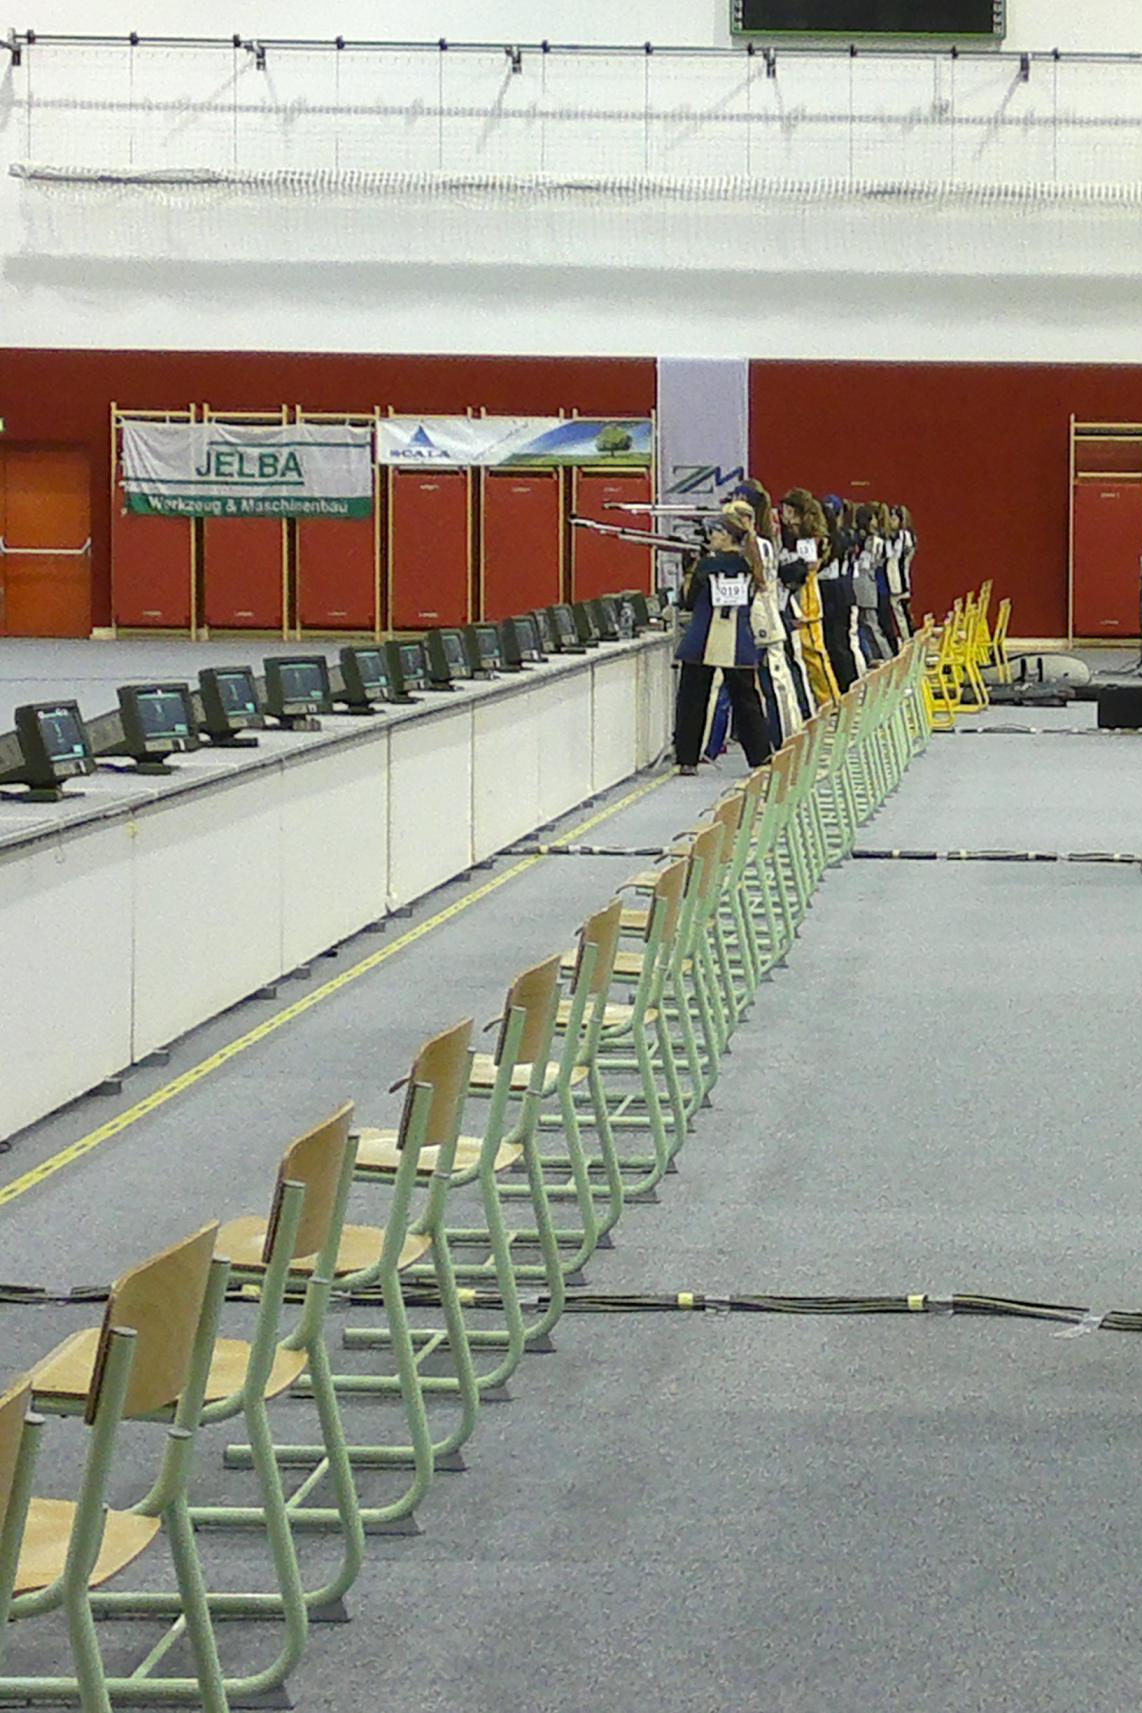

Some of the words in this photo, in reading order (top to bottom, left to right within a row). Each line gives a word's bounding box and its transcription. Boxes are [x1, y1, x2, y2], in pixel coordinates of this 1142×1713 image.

[196, 450, 304, 478] JELBA
[148, 496, 222, 516] Werkzeug
[225, 499, 237, 514] &
[241, 499, 348, 515] Maschinenbau
